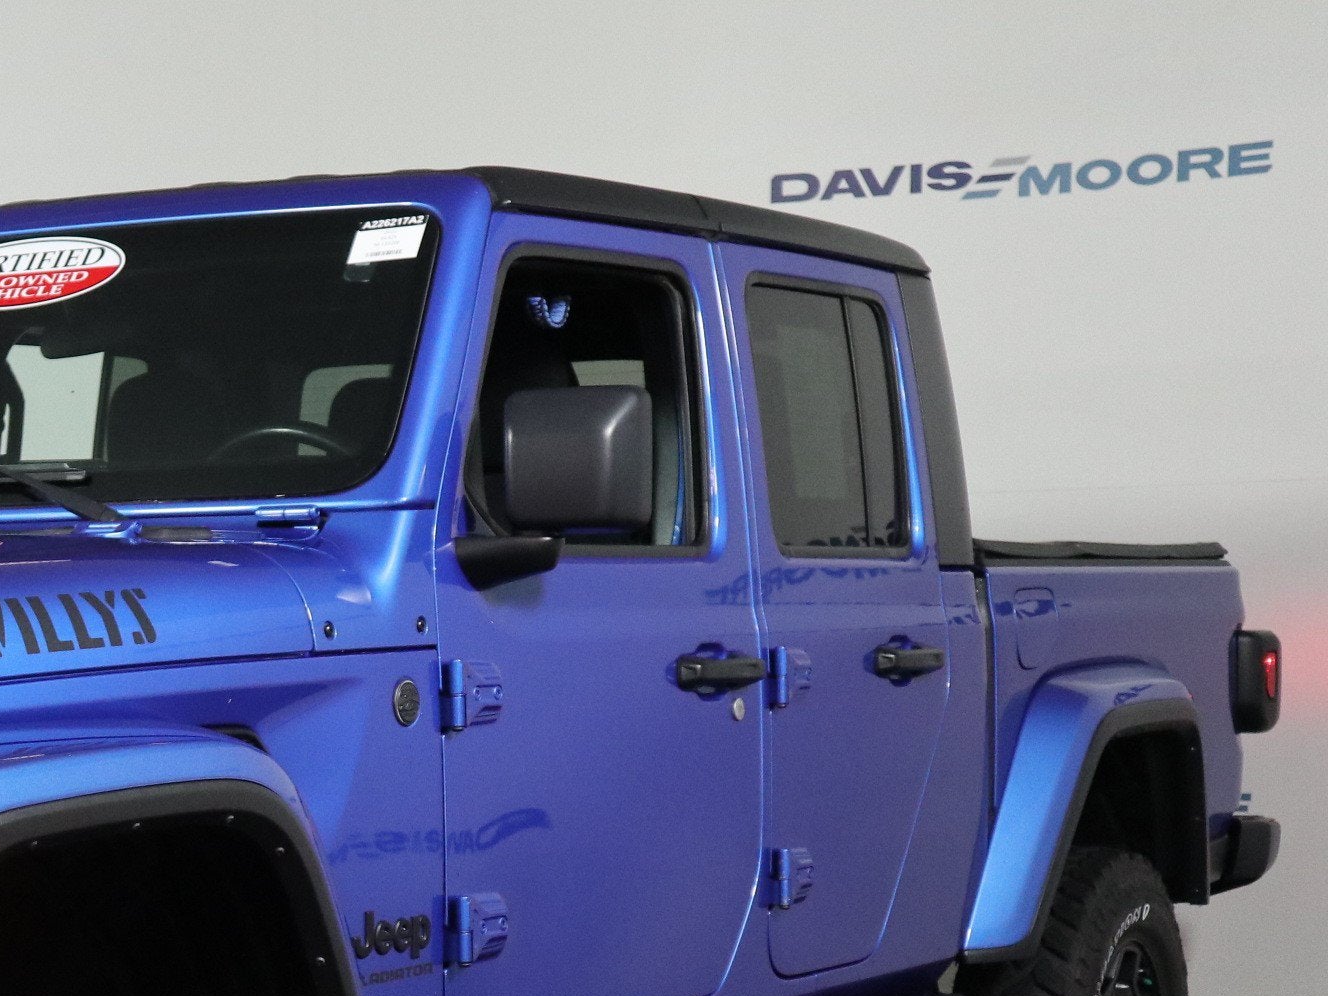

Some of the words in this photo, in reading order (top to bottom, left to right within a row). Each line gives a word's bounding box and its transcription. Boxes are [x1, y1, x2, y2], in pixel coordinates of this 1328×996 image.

[771, 160, 973, 204] DAVIS
[1018, 140, 1273, 198] MOORE
[352, 910, 431, 960] Jeep
